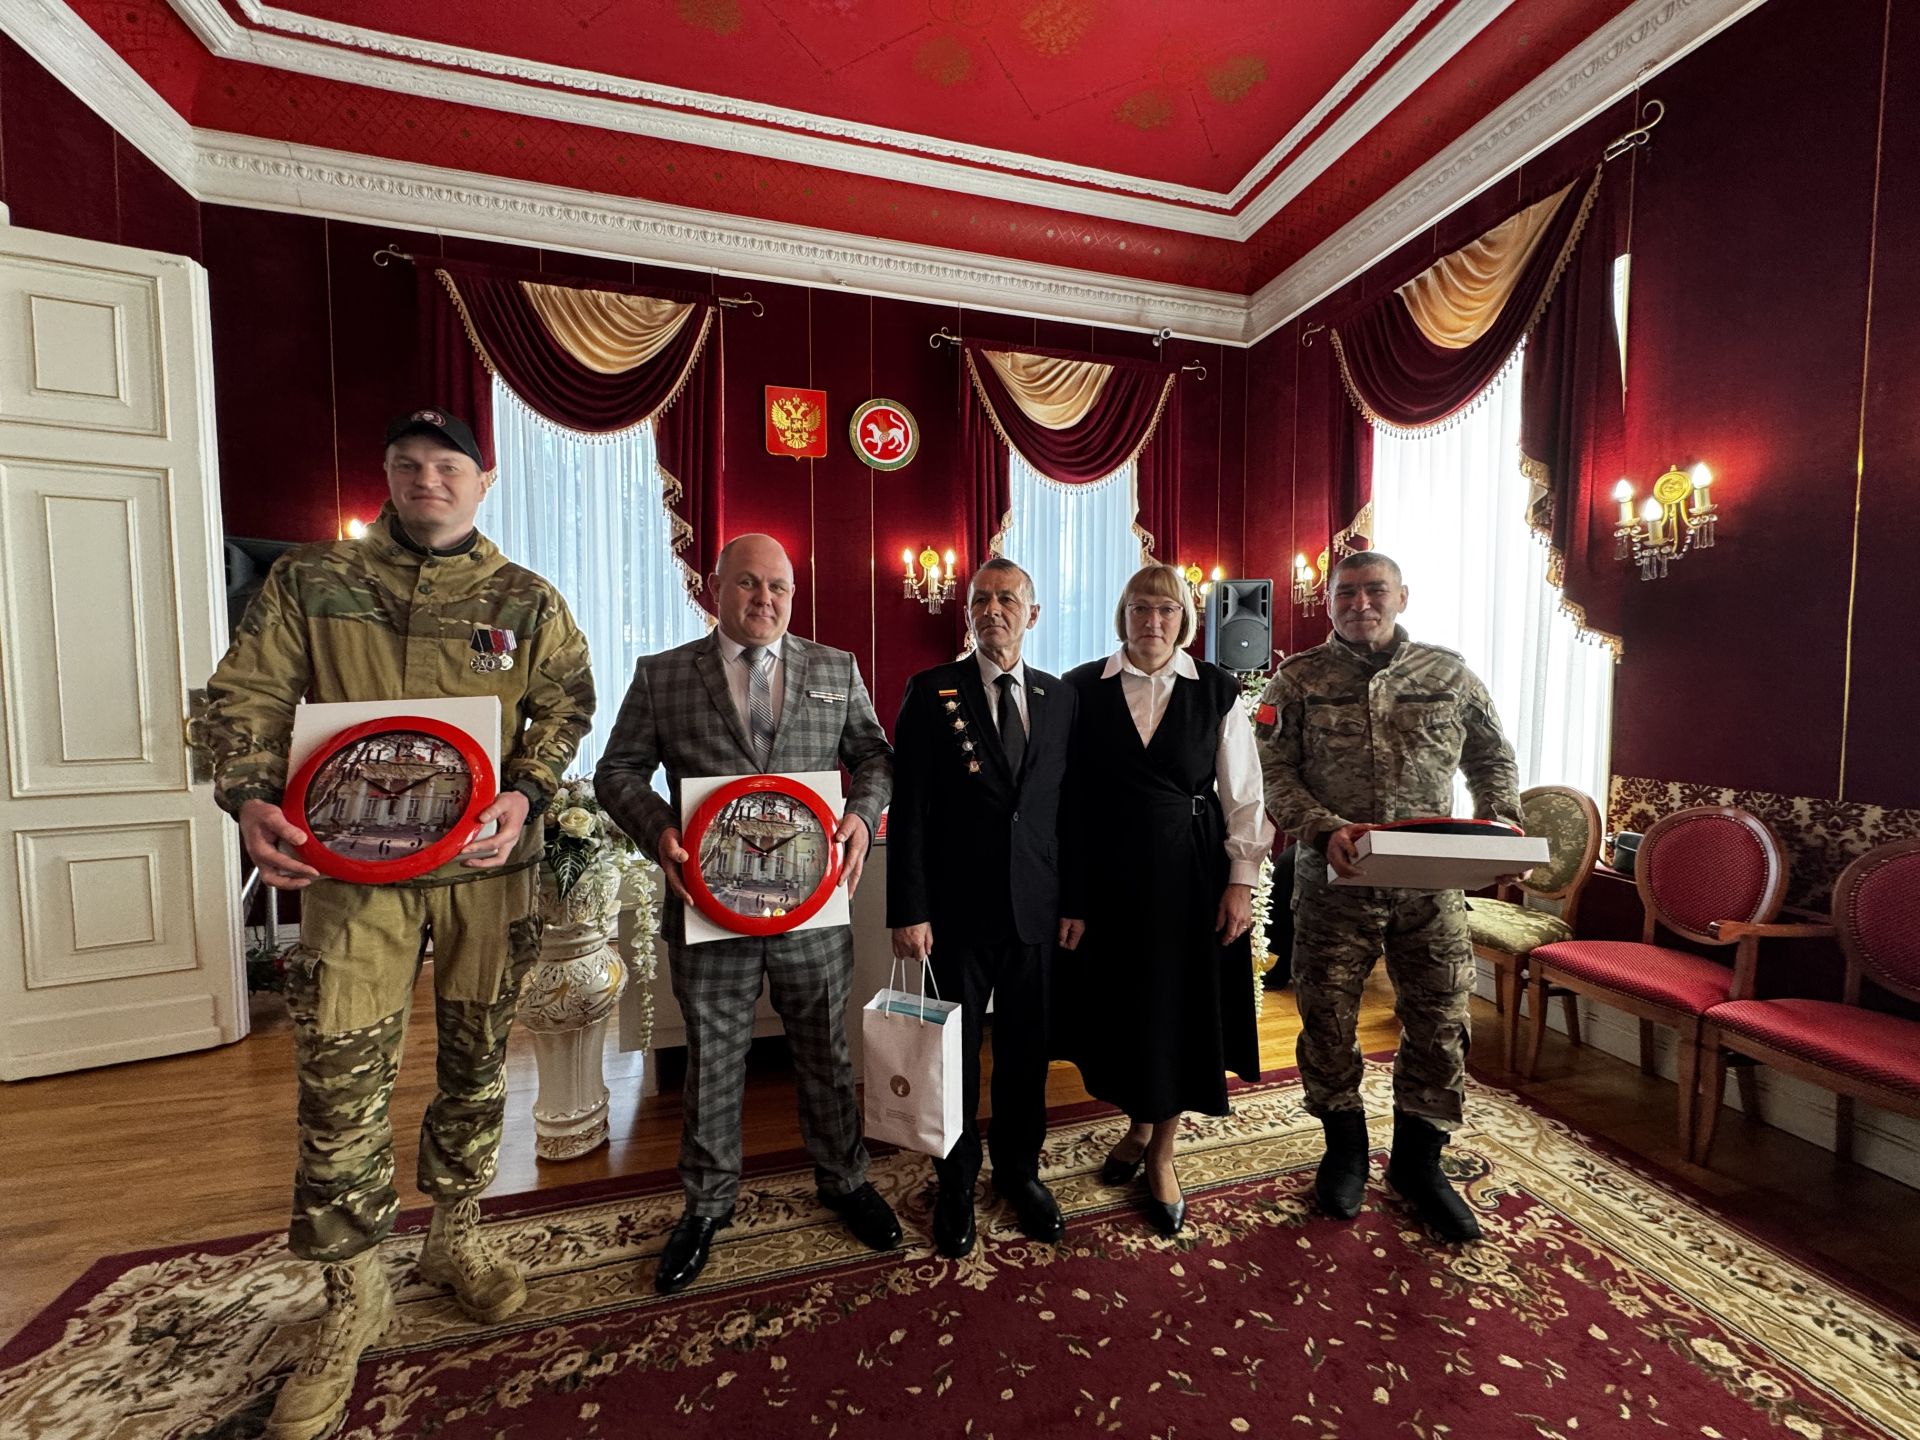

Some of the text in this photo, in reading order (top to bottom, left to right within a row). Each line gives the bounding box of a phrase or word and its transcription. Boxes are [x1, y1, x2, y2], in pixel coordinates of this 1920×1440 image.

[366, 749, 382, 764] 11
[395, 742, 414, 757] 12
[445, 765, 457, 781] 2
[450, 789, 461, 804] 3
[739, 806, 751, 821] 11
[762, 800, 777, 815] 12
[379, 839, 390, 857] 6
[756, 893, 765, 909] 6
